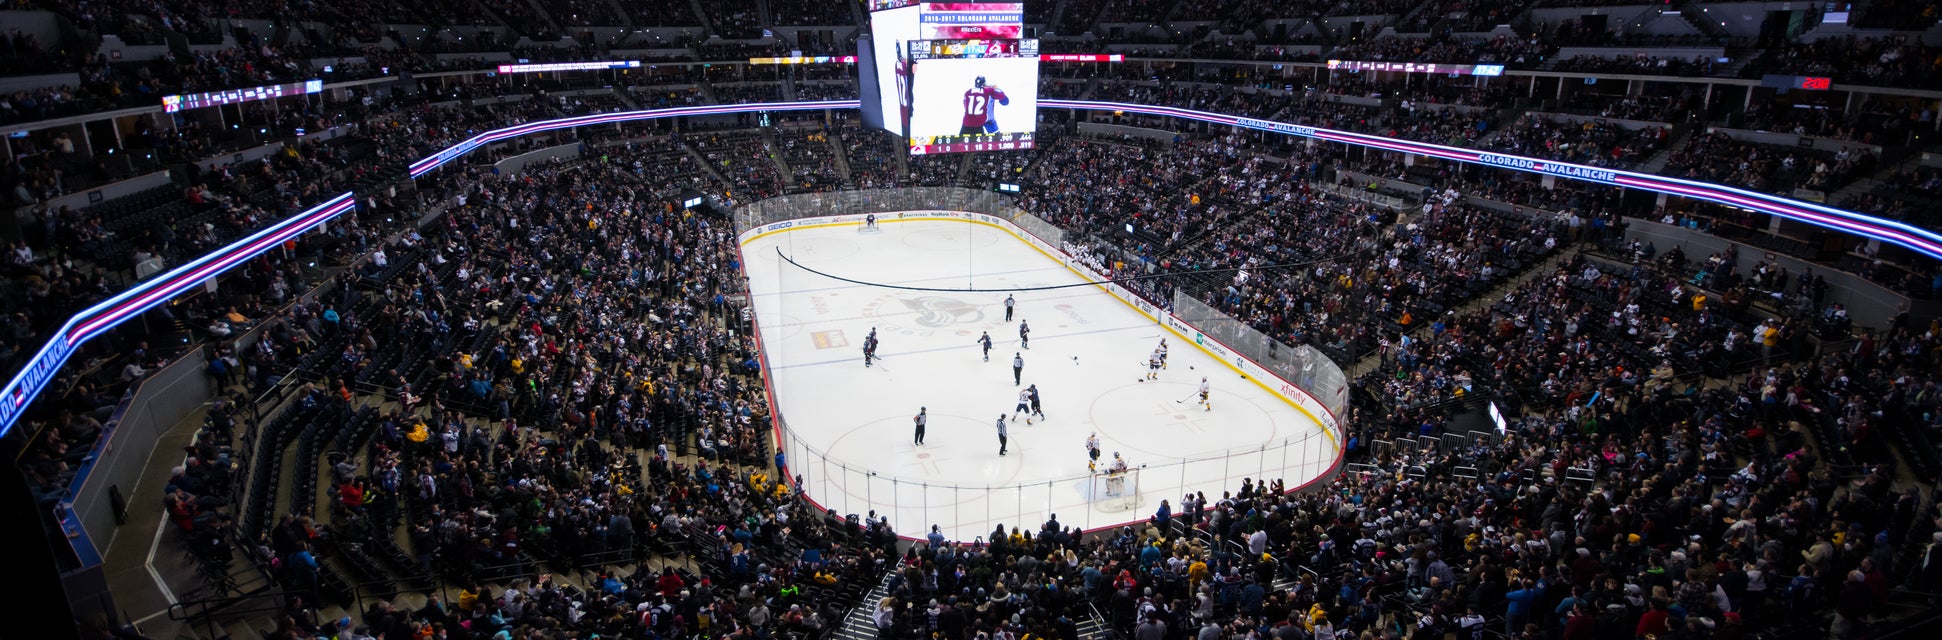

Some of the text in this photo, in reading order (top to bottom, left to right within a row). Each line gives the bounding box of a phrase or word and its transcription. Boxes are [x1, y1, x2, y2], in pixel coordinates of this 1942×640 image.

[1802, 77, 1831, 89] 2:08
[967, 95, 986, 116] 12
[1236, 118, 1315, 136] COLORADO AVALANCHE
[1478, 154, 1616, 182] COLORADO AVALANCHE
[768, 222, 792, 231] GEICO
[1174, 322, 1188, 333] RAM
[0, 333, 70, 426] DO AVALANCHE
[1280, 384, 1306, 406] xfinity
[651, 613, 658, 626] 9
